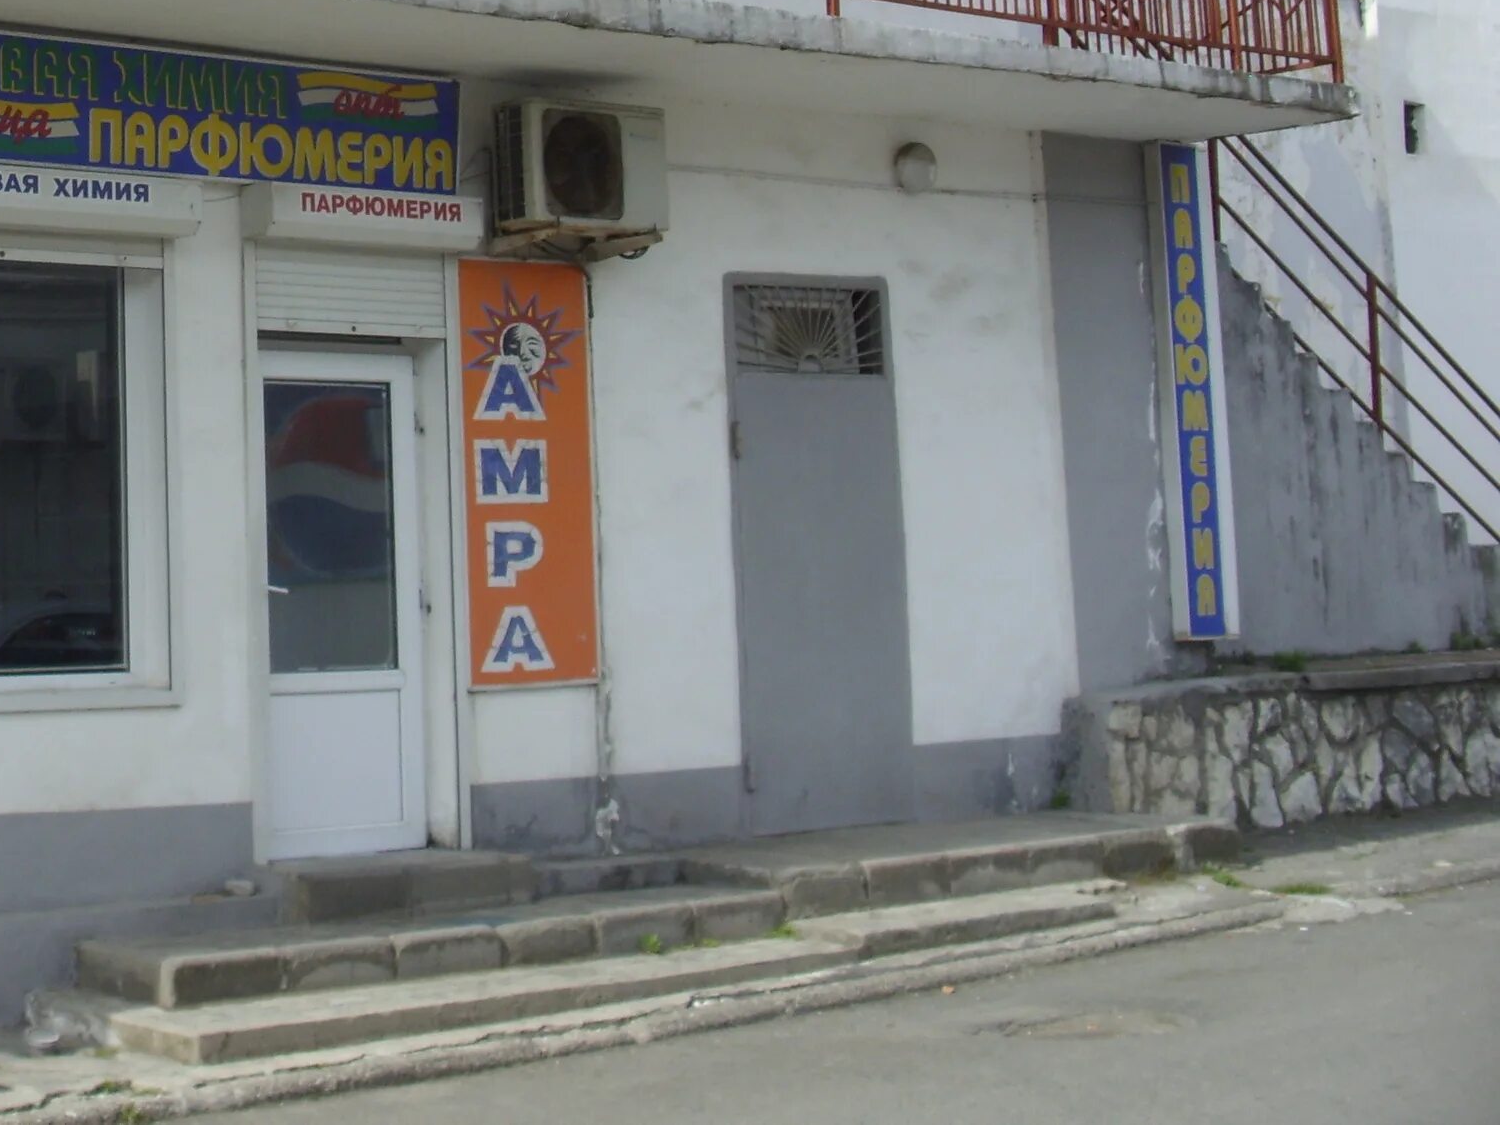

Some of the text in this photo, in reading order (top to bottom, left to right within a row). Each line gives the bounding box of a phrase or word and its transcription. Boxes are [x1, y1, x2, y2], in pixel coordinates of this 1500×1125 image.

[112, 48, 288, 120] ХИМИЯ
[88, 107, 455, 192] ПАРФЮМЕРИЯ
[52, 177, 150, 203] ХИМИЯ
[300, 191, 462, 223] ПАРФЮМЕРИЯ
[1170, 164, 1217, 617] ПАРФЮМЕРИЯ
[473, 355, 555, 673] АМРА
